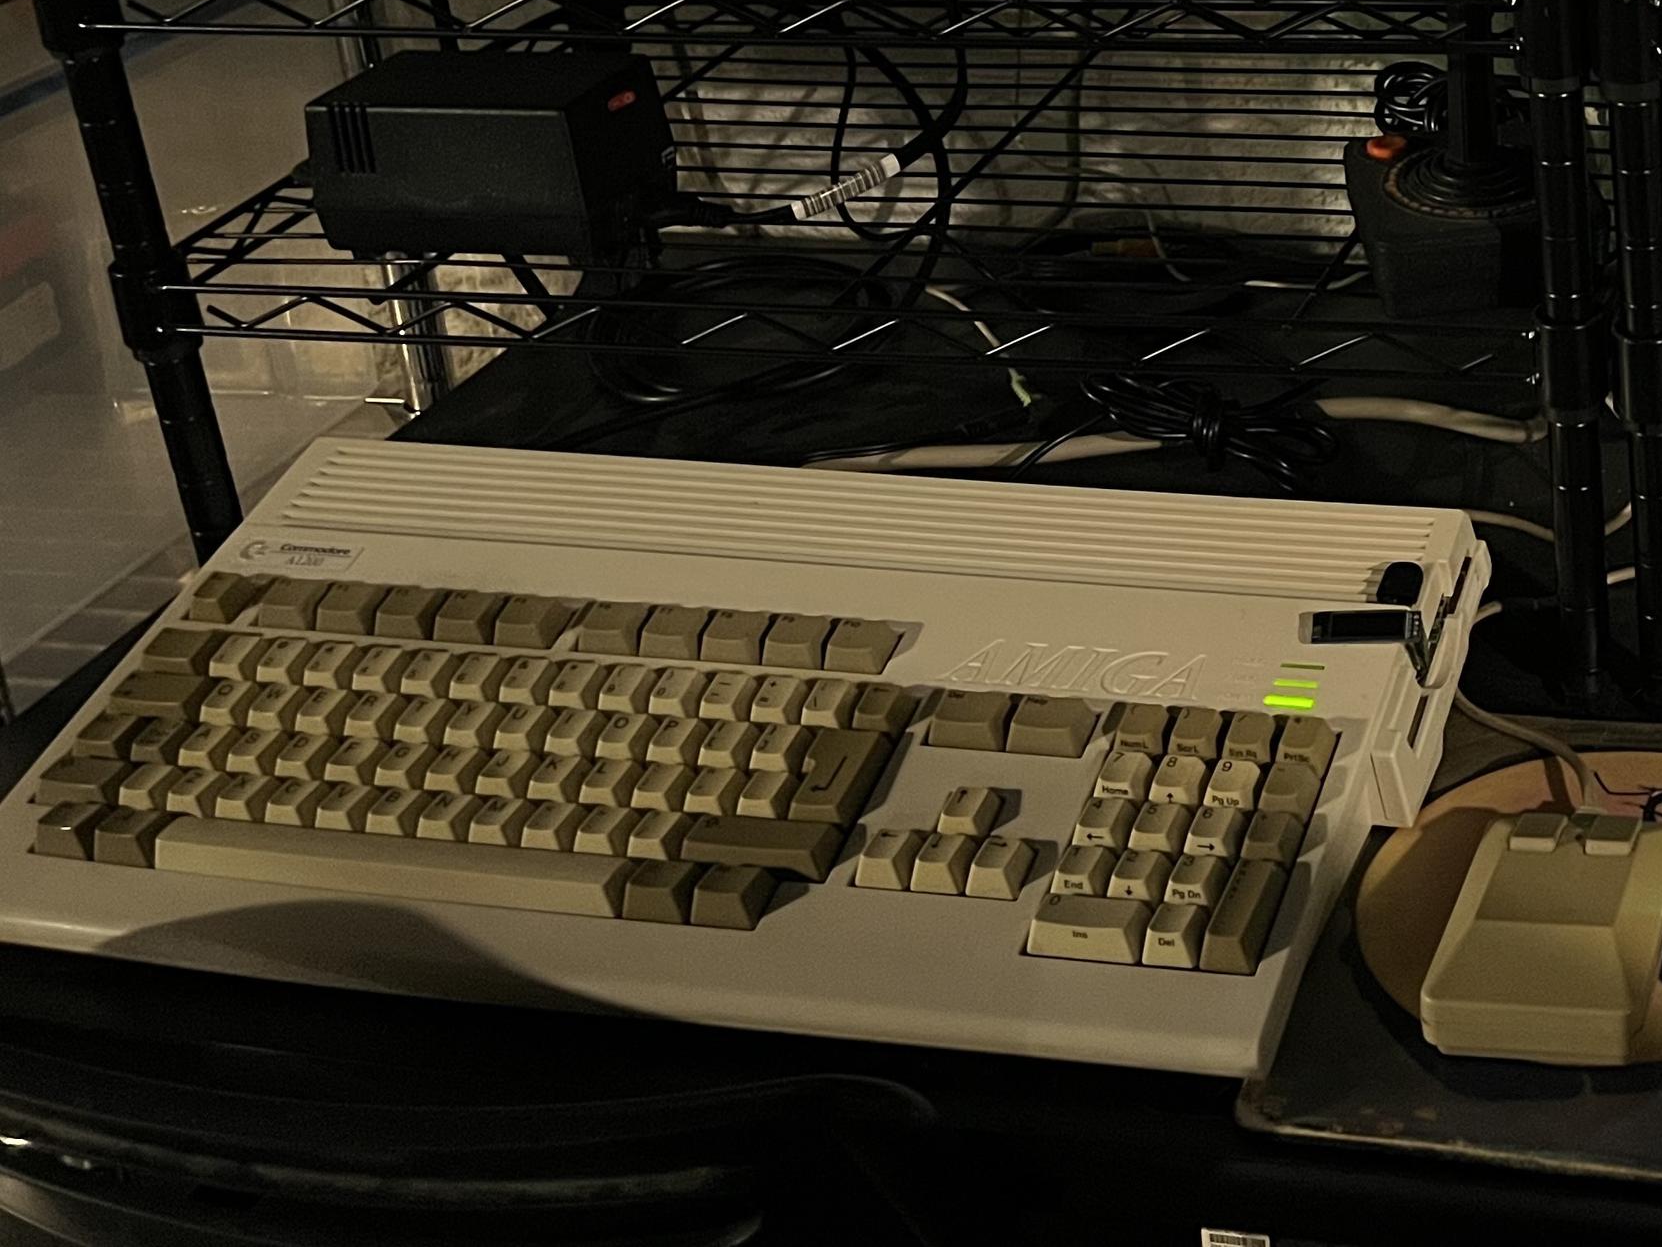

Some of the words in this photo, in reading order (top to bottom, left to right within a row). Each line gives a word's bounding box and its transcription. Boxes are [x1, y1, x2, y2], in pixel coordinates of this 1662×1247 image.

[939, 638, 1208, 700] AMIGA
[1166, 756, 1179, 769] 8
[1220, 761, 1233, 773] 9
[1101, 785, 1129, 796] Home
[1063, 879, 1083, 890] End
[1072, 930, 1089, 940] Ins
[1157, 937, 1176, 947] Del
